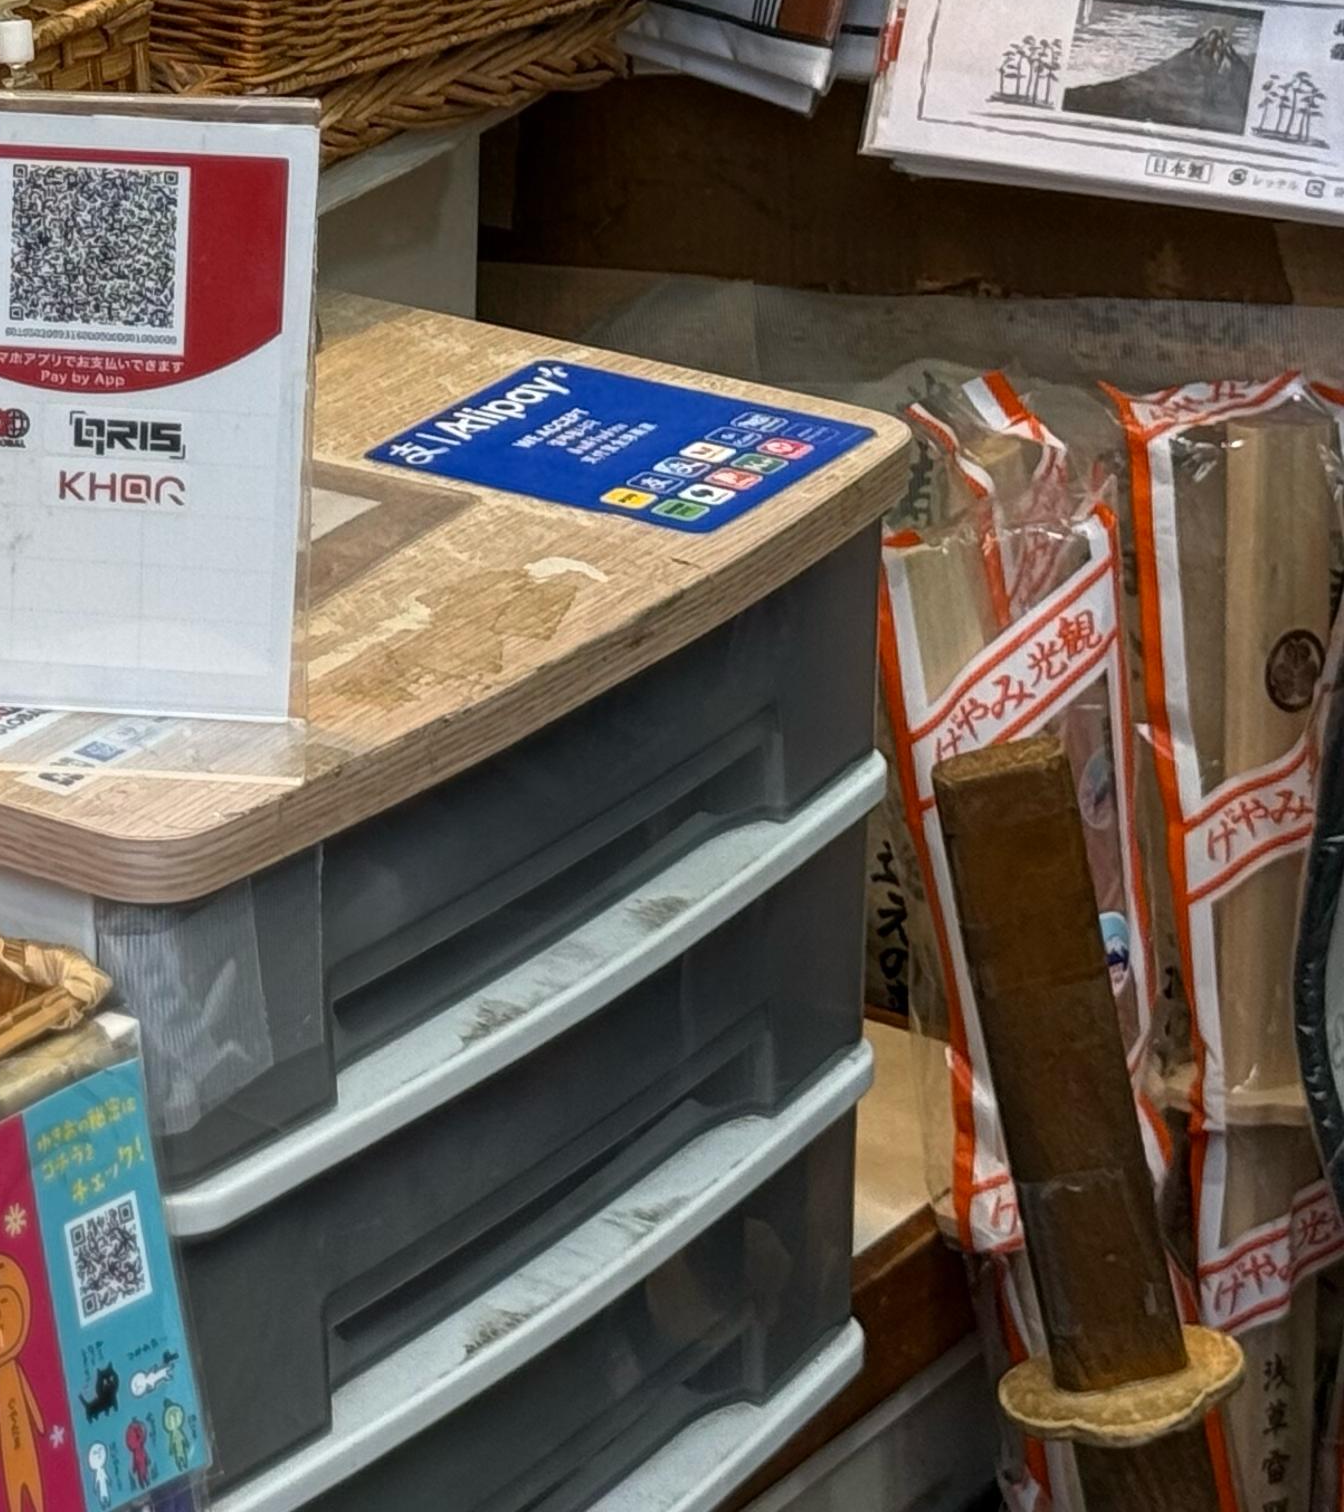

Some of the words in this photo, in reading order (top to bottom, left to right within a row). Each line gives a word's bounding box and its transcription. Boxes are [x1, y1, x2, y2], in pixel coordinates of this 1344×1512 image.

[1153, 159, 1209, 180] 日本製
[40, 370, 68, 386] Pay
[71, 371, 90, 387] by
[93, 374, 126, 388] App
[72, 413, 185, 458] QRIS
